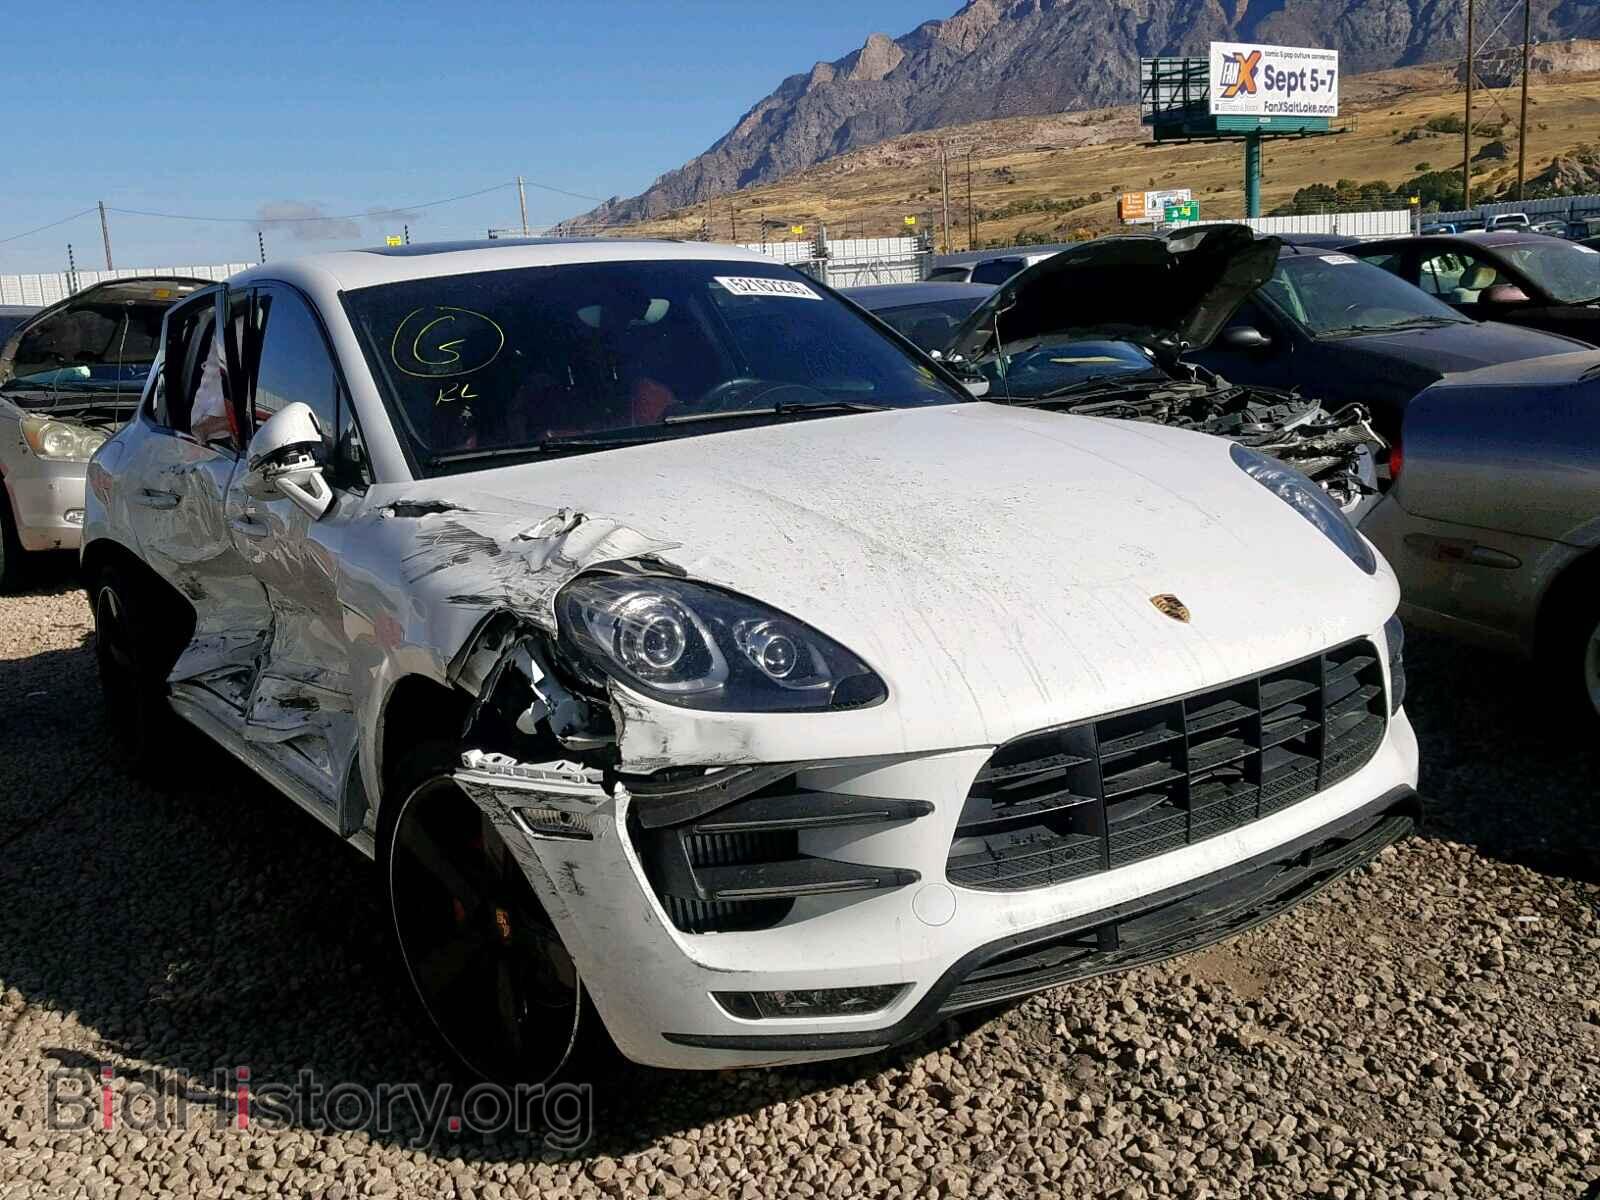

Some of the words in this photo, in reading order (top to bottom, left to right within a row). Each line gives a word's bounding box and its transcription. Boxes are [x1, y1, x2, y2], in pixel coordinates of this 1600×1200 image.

[1264, 64, 1306, 97] Sept
[1310, 68, 1336, 93] 5-7
[1264, 100, 1335, 114] FanXSaltLake.com
